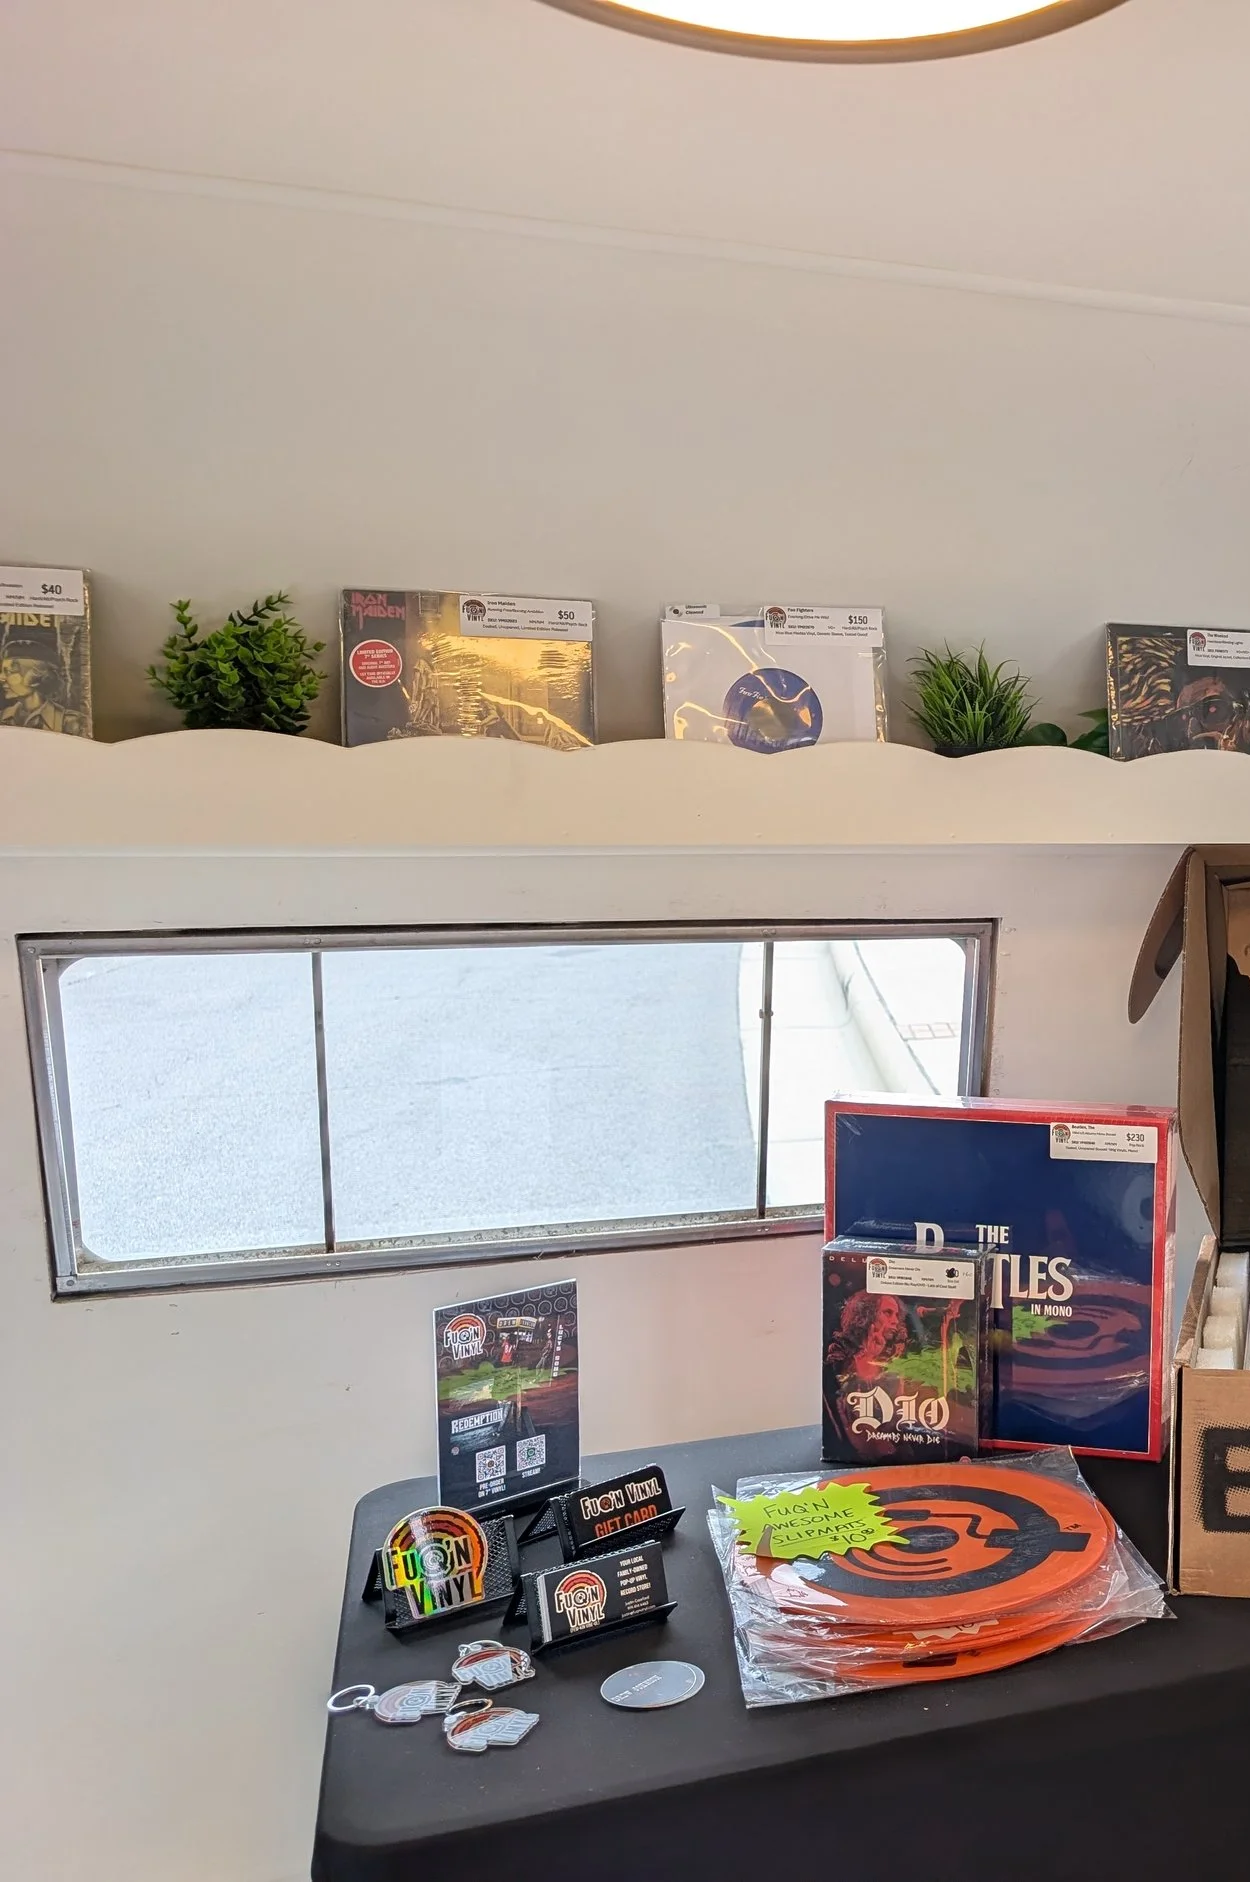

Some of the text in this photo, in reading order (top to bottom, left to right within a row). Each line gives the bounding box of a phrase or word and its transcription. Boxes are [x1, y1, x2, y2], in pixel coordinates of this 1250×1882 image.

[42, 584, 62, 594] $40
[351, 592, 387, 607] IRON
[351, 604, 405, 630] MAIDEN
[558, 610, 574, 620] $50
[848, 614, 868, 626] $150
[1126, 1133, 1144, 1142] $230
[976, 1224, 1010, 1244] THE
[1031, 1304, 1072, 1318] IN MONO
[444, 1326, 481, 1348] FUQ'N
[452, 1341, 483, 1360] VINYL
[847, 1386, 950, 1434] DIO
[451, 1408, 504, 1434] REDEMPTION
[866, 1430, 940, 1444] DREAMERS NEVER DIE
[580, 1477, 662, 1520] FUQ'N VINYL
[763, 1498, 830, 1519] FUQ'N
[595, 1516, 622, 1538] GIFT
[762, 1508, 855, 1533] AWESOME
[772, 1518, 867, 1545] SLIPMATS
[388, 1536, 474, 1589] FUQ'N
[616, 1564, 648, 1578] FAMILY-OWNED
[620, 1555, 644, 1567] YOUR LOCAL
[620, 1573, 648, 1587] POP-UP VINYL
[408, 1570, 486, 1616] VINYL
[555, 1585, 600, 1614] FUQ'N
[620, 1586, 636, 1596] RECORD
[566, 1603, 606, 1628] VINYL
